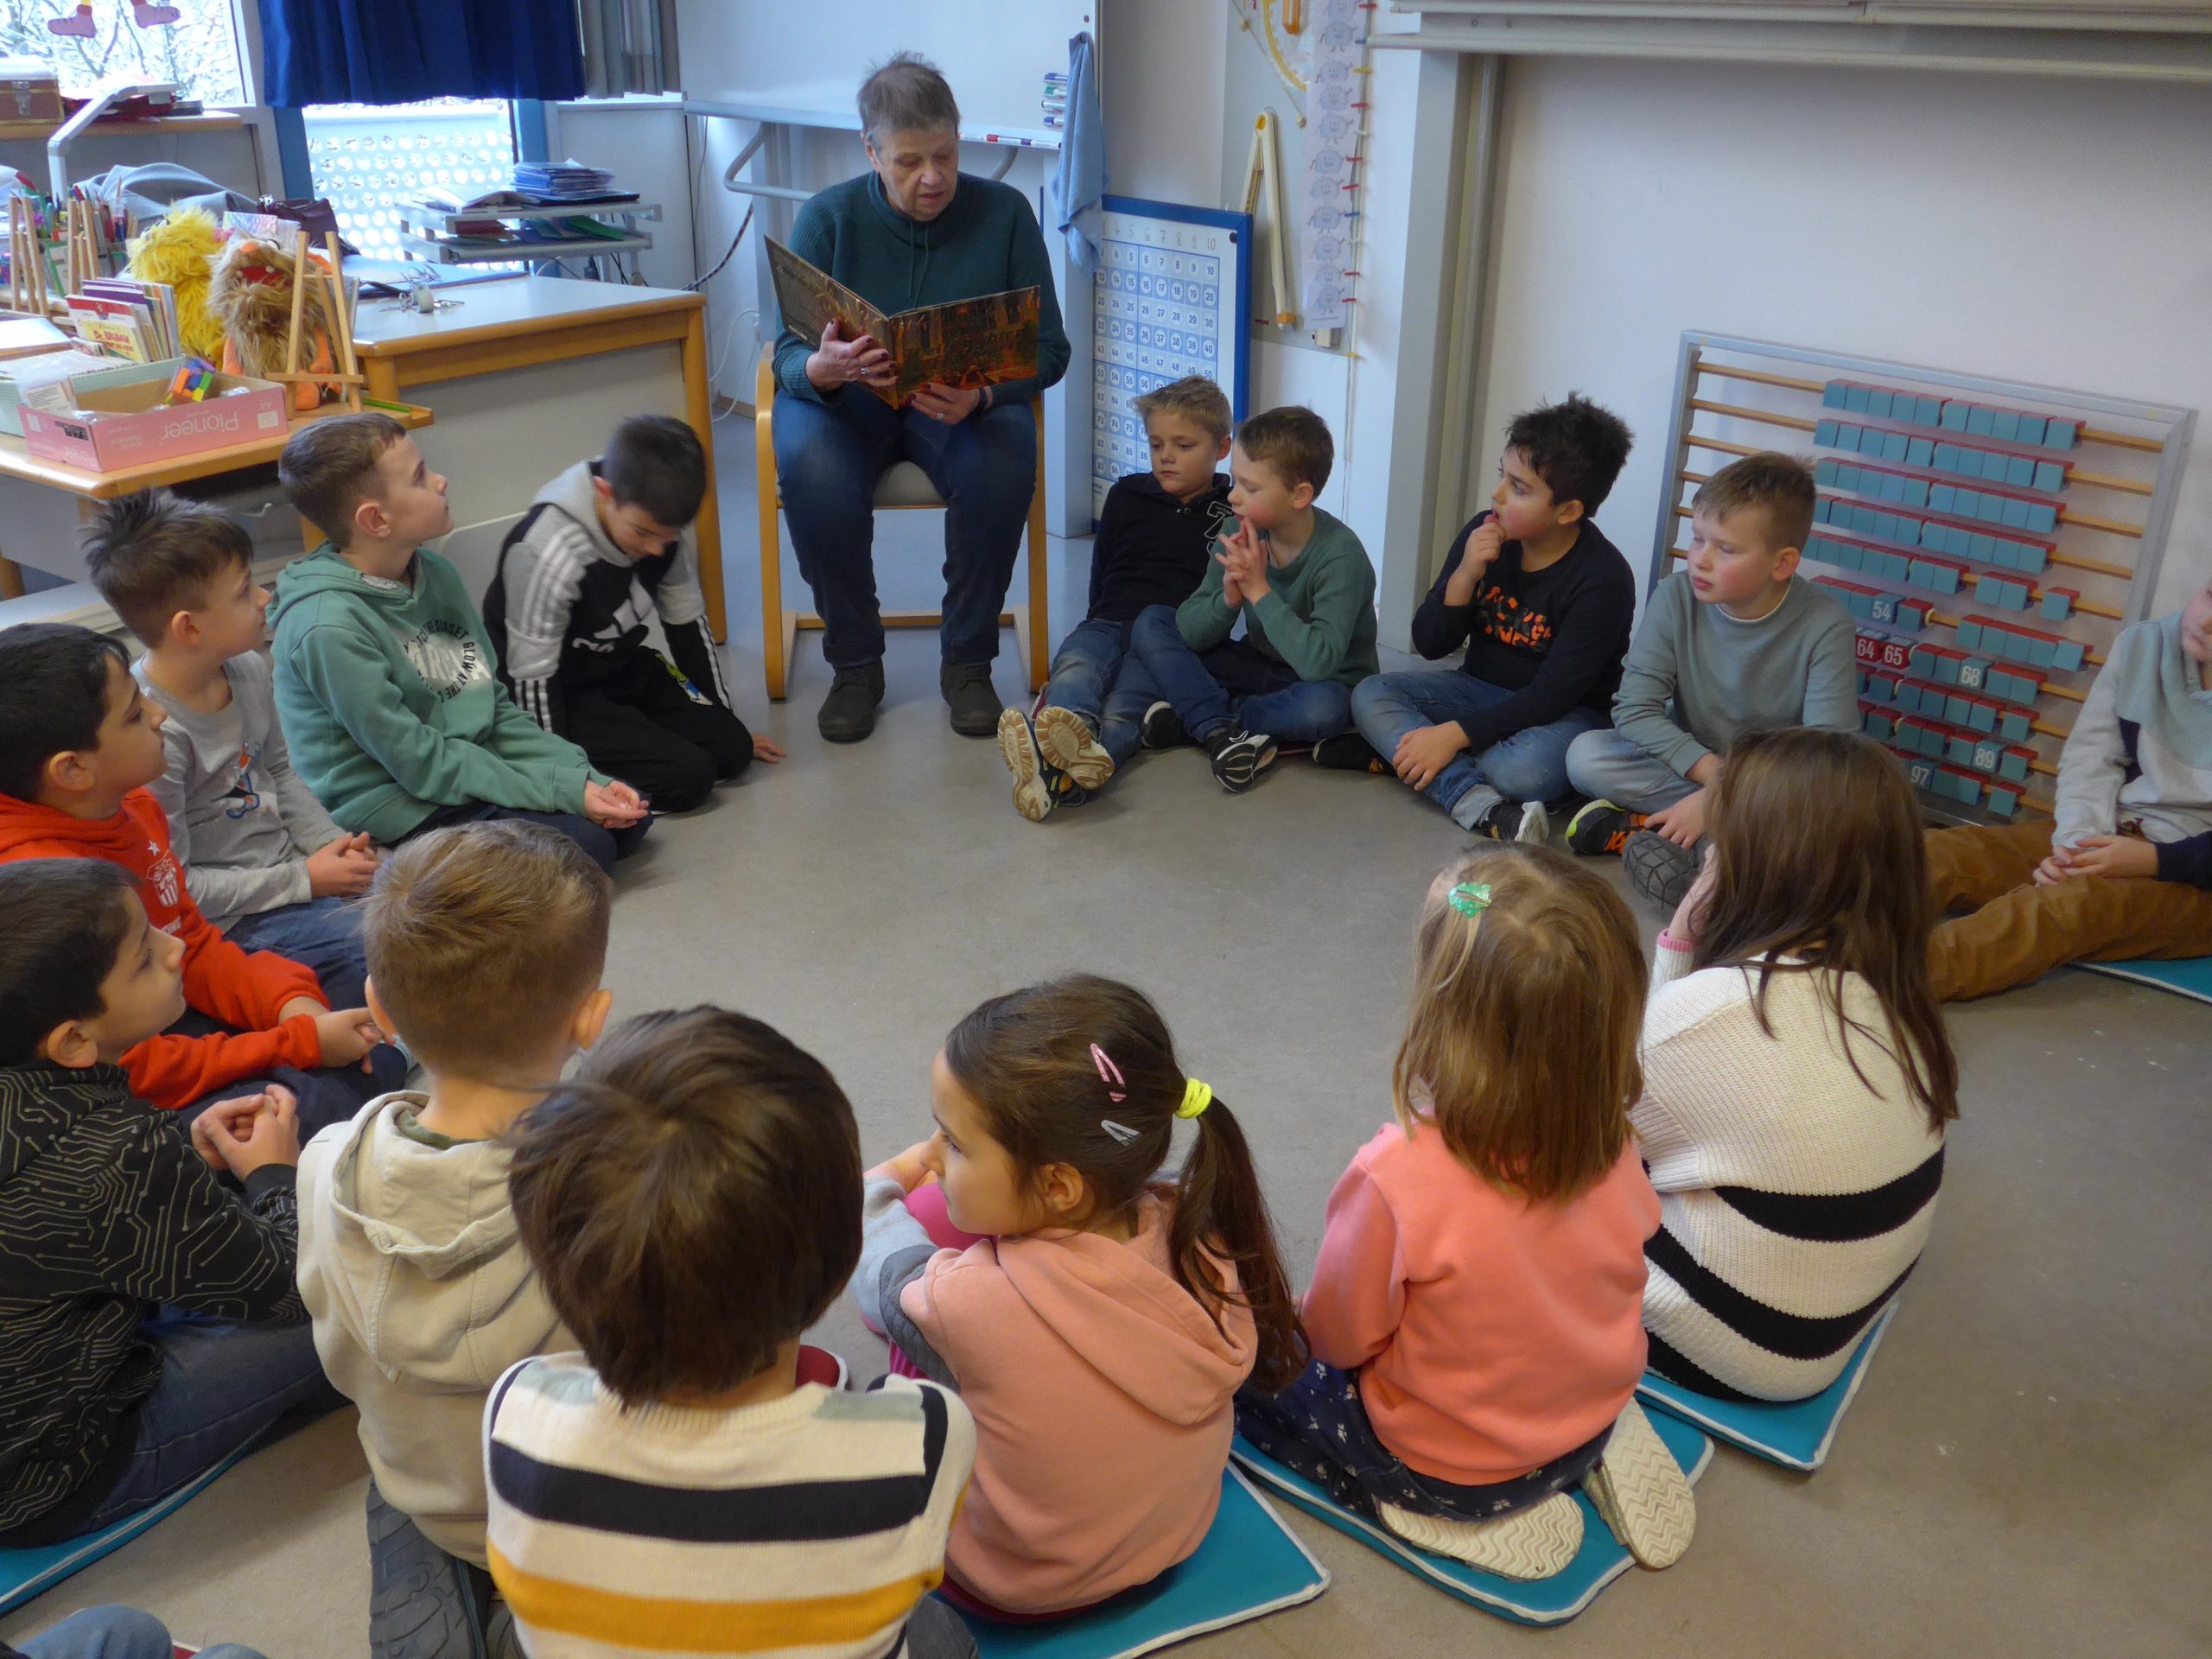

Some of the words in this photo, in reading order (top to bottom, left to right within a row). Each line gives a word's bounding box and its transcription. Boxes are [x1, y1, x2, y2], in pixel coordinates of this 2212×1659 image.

[1128, 252, 1134, 261] 5
[1144, 255, 1148, 264] 6
[1160, 257, 1164, 266] 7
[1175, 260, 1180, 270] 8
[1191, 263, 1196, 272] 9
[1207, 266, 1214, 276] 10
[1098, 272, 1105, 282] 13
[1128, 277, 1135, 287] 15
[1142, 280, 1149, 289] 16
[1159, 283, 1165, 292] 17
[1174, 286, 1181, 296] 18
[1190, 289, 1197, 299] 19
[1205, 292, 1214, 302] 20
[1097, 296, 1105, 306] 23
[1112, 299, 1120, 308] 24
[1127, 302, 1135, 312] 25
[1141, 305, 1149, 315] 26
[1157, 308, 1165, 318] 27
[1173, 311, 1180, 321] 28
[1188, 315, 1197, 325] 29
[1205, 318, 1214, 328] 30
[1097, 320, 1105, 330] 33
[1111, 322, 1119, 333] 34
[1126, 326, 1134, 336] 35
[1141, 329, 1149, 340] 36
[1156, 333, 1164, 343] 37
[1172, 336, 1180, 346] 38
[1188, 340, 1197, 350] 39
[1205, 343, 1213, 354] 40
[1096, 345, 1104, 355] 43
[1111, 347, 1119, 357] 44
[1126, 351, 1134, 361] 45
[1141, 354, 1149, 365] 46
[1155, 358, 1164, 368] 47
[1171, 362, 1179, 372] 48
[1187, 365, 1196, 375] 49
[1096, 368, 1104, 378] 53
[1111, 371, 1119, 381] 54
[1126, 374, 1134, 385] 55
[1141, 378, 1148, 389] 56
[1096, 391, 1104, 402] 63
[1110, 396, 1119, 405] 64
[162, 410, 239, 441] Pioneer
[1096, 415, 1104, 424] 73
[1111, 418, 1119, 429] 74
[1125, 423, 1134, 433] 75
[1096, 438, 1104, 448] 83
[1111, 442, 1119, 451] 84
[1125, 446, 1134, 456] 85
[1140, 450, 1148, 461] 86
[1872, 600, 1891, 620] 54
[461, 641, 475, 673] GLOW
[1856, 638, 1875, 658] 64
[1884, 645, 1904, 666] 65
[455, 671, 468, 686] AT
[1961, 664, 1980, 687] 68
[444, 681, 461, 700] THE
[1974, 747, 1995, 769] 89
[1910, 764, 1930, 785] 97
